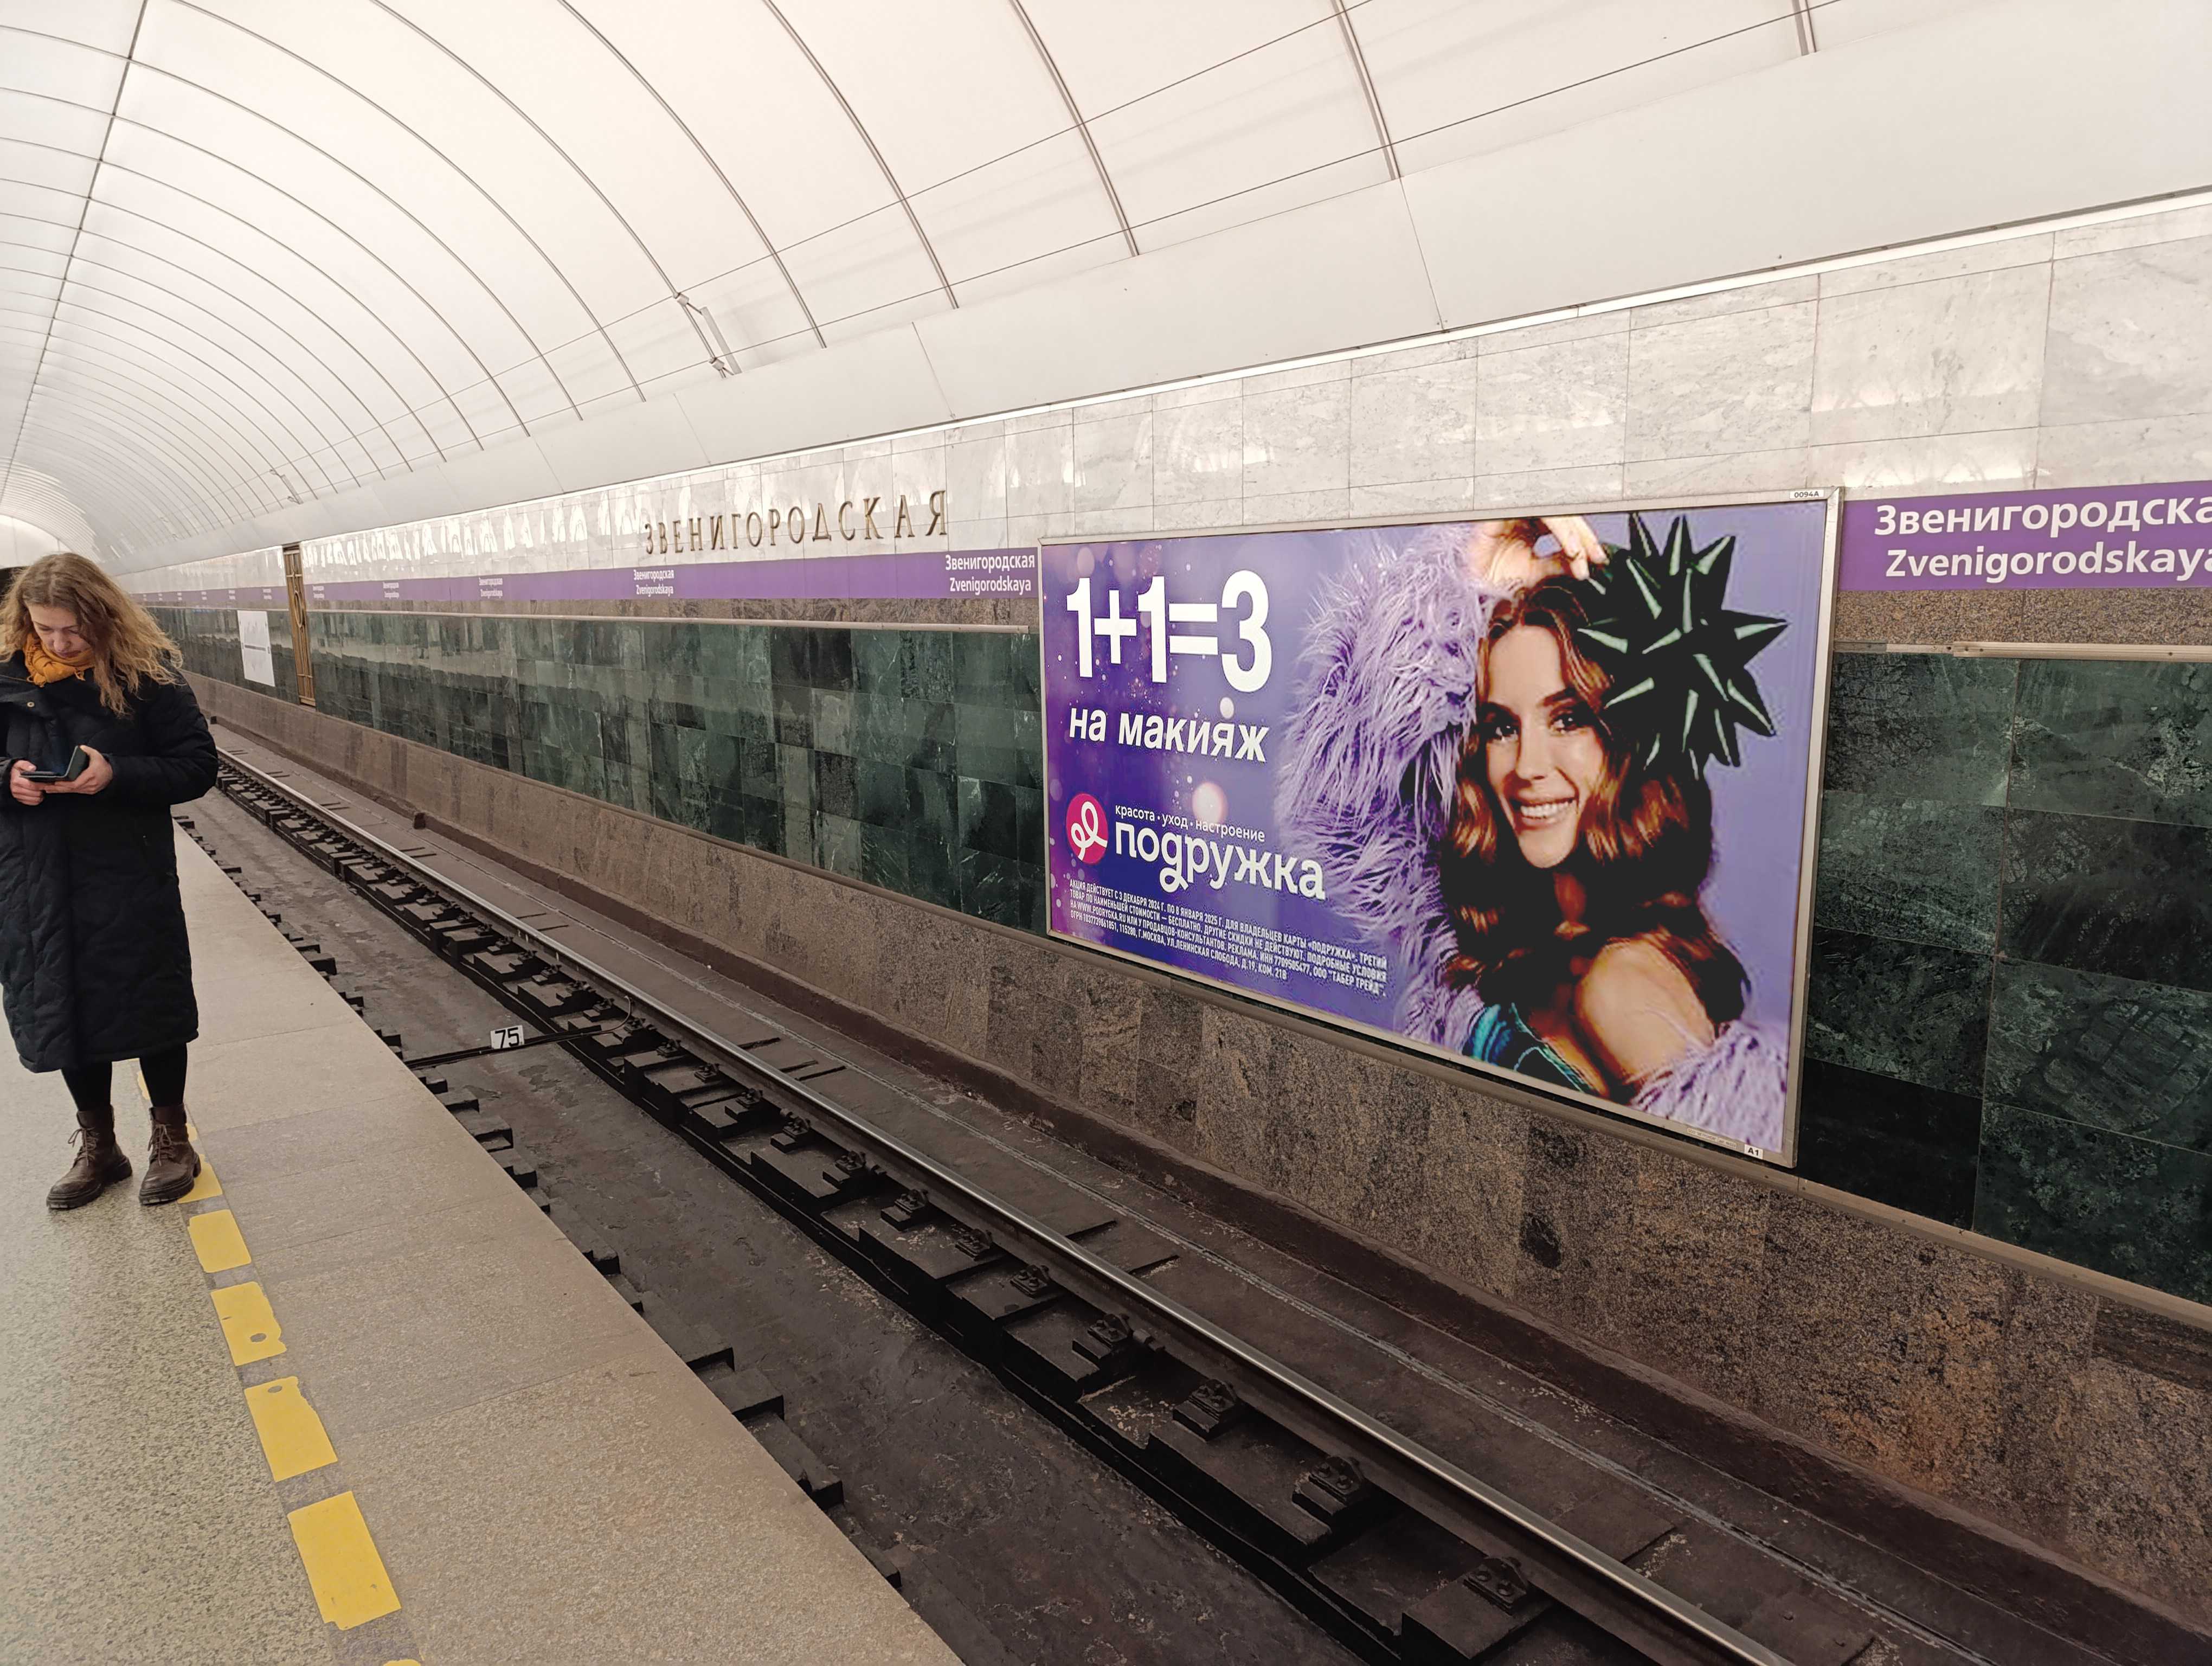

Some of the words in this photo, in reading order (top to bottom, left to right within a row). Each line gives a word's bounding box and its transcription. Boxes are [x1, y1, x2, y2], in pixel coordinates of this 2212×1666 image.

[645, 490, 947, 554] ЗВЕНИГОРОДСКАЯ
[633, 569, 674, 582] Звенигородская
[946, 555, 1035, 573] Звенигородская
[950, 575, 1031, 595] Zvenigorodskaya
[1066, 570, 1272, 693] 1+1=3
[1069, 707, 1106, 742] на
[1118, 712, 1270, 762] макияж
[1115, 805, 1155, 821] красота
[1162, 813, 1188, 828] уход
[1196, 820, 1265, 842] настроение
[1115, 822, 1326, 900] подружка
[1070, 879, 1085, 890] АКЦИЯ
[1086, 883, 1114, 898] ДЕЙСТВУЕТ
[1115, 890, 1118, 899] С
[1119, 892, 1122, 900] 3
[1123, 893, 1147, 907] ДЕКАБРЯ
[1148, 899, 1160, 910] 2024
[1161, 902, 1166, 912] Г.
[1167, 904, 1174, 913] ПО
[1180, 908, 1203, 921] ЯНВАРЯ
[1204, 914, 1218, 925] 2025
[1219, 917, 1224, 927] Г.
[1225, 919, 1238, 930] ДЛЯ
[1240, 922, 1282, 942] ВЛАДЕЛЬЦЕВ
[1283, 934, 1307, 949] КАРТЫ
[1359, 952, 1387, 970] ТРЕТИЙ
[1070, 889, 1085, 899] ТОВАР
[1086, 893, 1092, 902] ПО
[1094, 895, 1128, 911] НАИМЕНЬШЕЙ
[1129, 905, 1160, 921] СТОИМОСТИ
[1168, 915, 1203, 933] БЕСПЛАТНО.
[1204, 925, 1226, 939] ДРУГИЕ
[1227, 931, 1253, 947] СКИДКИ
[1255, 938, 1263, 950] НЕ
[1264, 940, 1305, 961] ДЕЙСТВУЮТ.
[1307, 952, 1351, 974] ПОДРОБНЫЕ
[1352, 963, 1387, 983] УСЛОВИЯ
[1070, 900, 1077, 908] НА
[1077, 901, 1126, 922] WWW.PODRYGKA.RU
[1127, 914, 1137, 925] ИЛИ
[1138, 917, 1142, 926] У
[1227, 943, 1259, 960] РЕКЛАМА.
[1260, 951, 1273, 964] ИНН
[1313, 967, 1328, 979] ООО
[1070, 910, 1082, 920] ОГРН
[1119, 924, 1137, 938] 115280,
[1139, 930, 1166, 946] Г.МОСКВА,
[1167, 937, 1210, 958] УЛ.ЛЕНИНСКАЯ
[1211, 950, 1240, 968] СЛОБОДА,
[1258, 963, 1274, 976] КОМ.
[495, 1027, 519, 1048] 75
